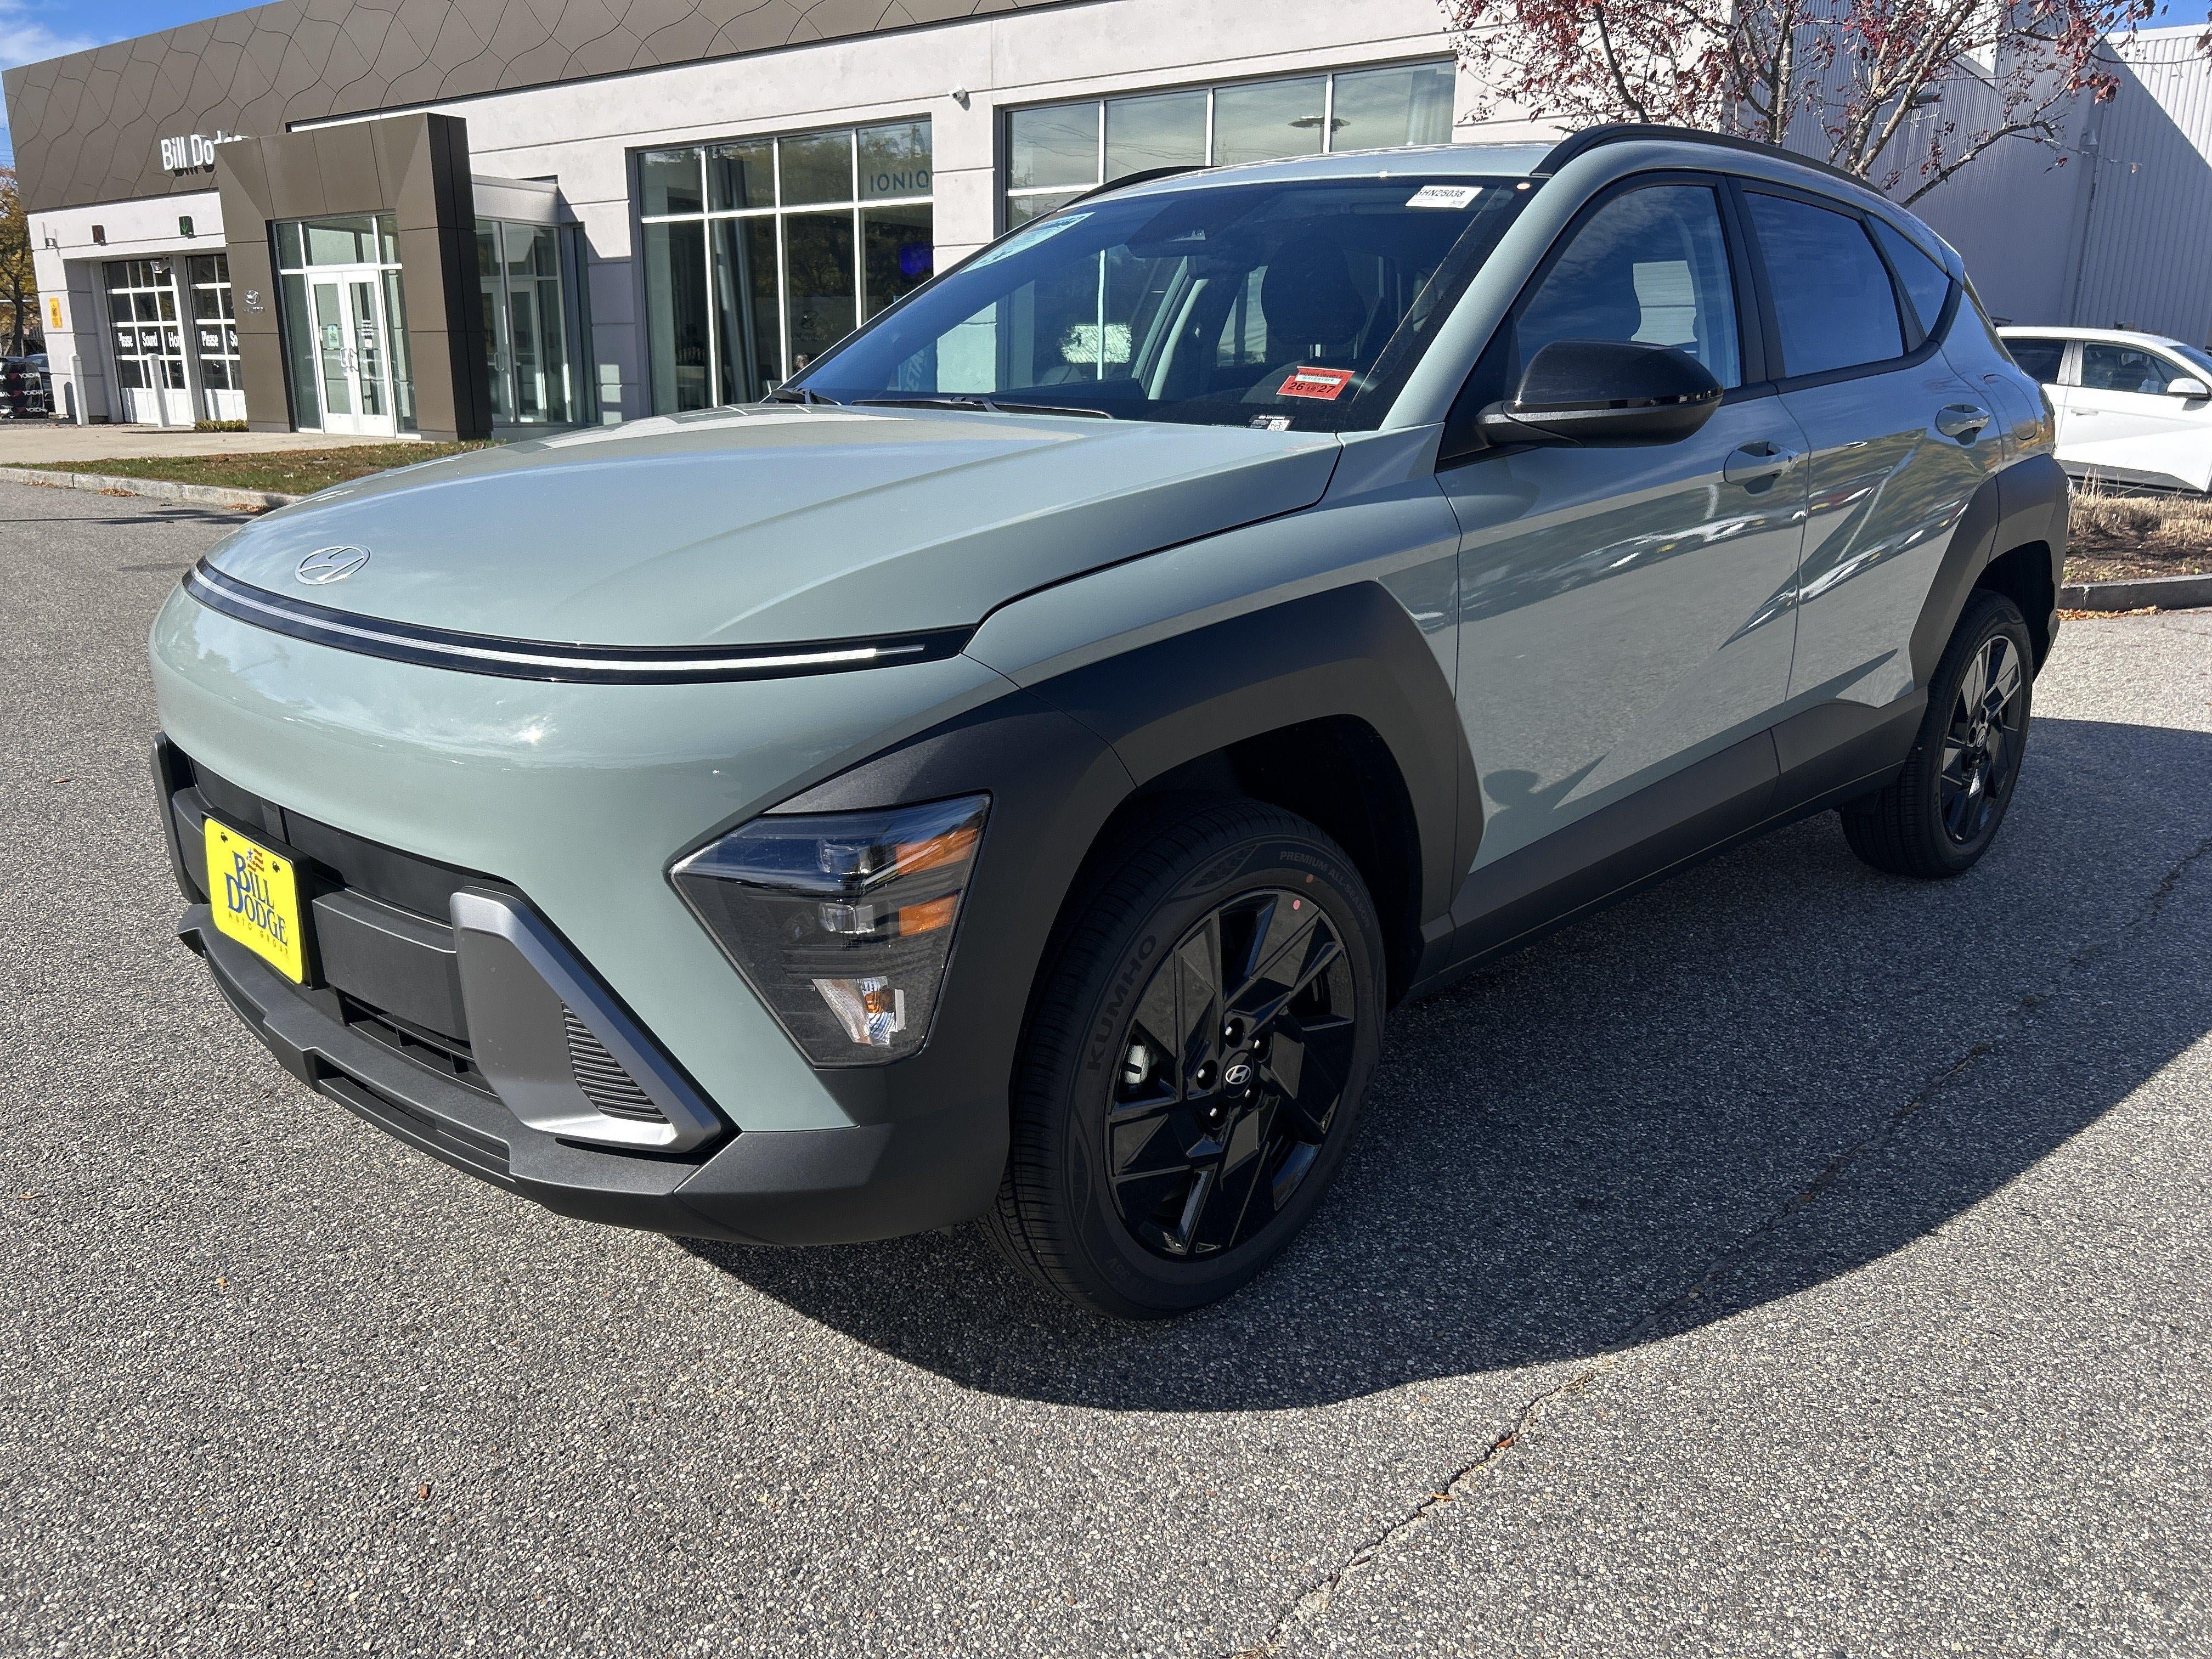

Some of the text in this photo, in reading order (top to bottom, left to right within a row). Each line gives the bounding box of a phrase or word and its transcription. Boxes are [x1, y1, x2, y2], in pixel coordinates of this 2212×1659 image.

[161, 136, 188, 171] Bill
[870, 170, 929, 192] IONIQ
[117, 332, 133, 347] Please
[141, 331, 158, 347] Sound
[200, 330, 219, 347] Please
[1288, 382, 1306, 391] 26
[1317, 385, 1336, 394] 27
[1279, 851, 1329, 872] PREMIUM
[232, 850, 274, 909] BILL
[224, 872, 288, 946] DODGE
[229, 912, 289, 956] AUTO GROUP
[1087, 934, 1156, 1071] KUMHO
